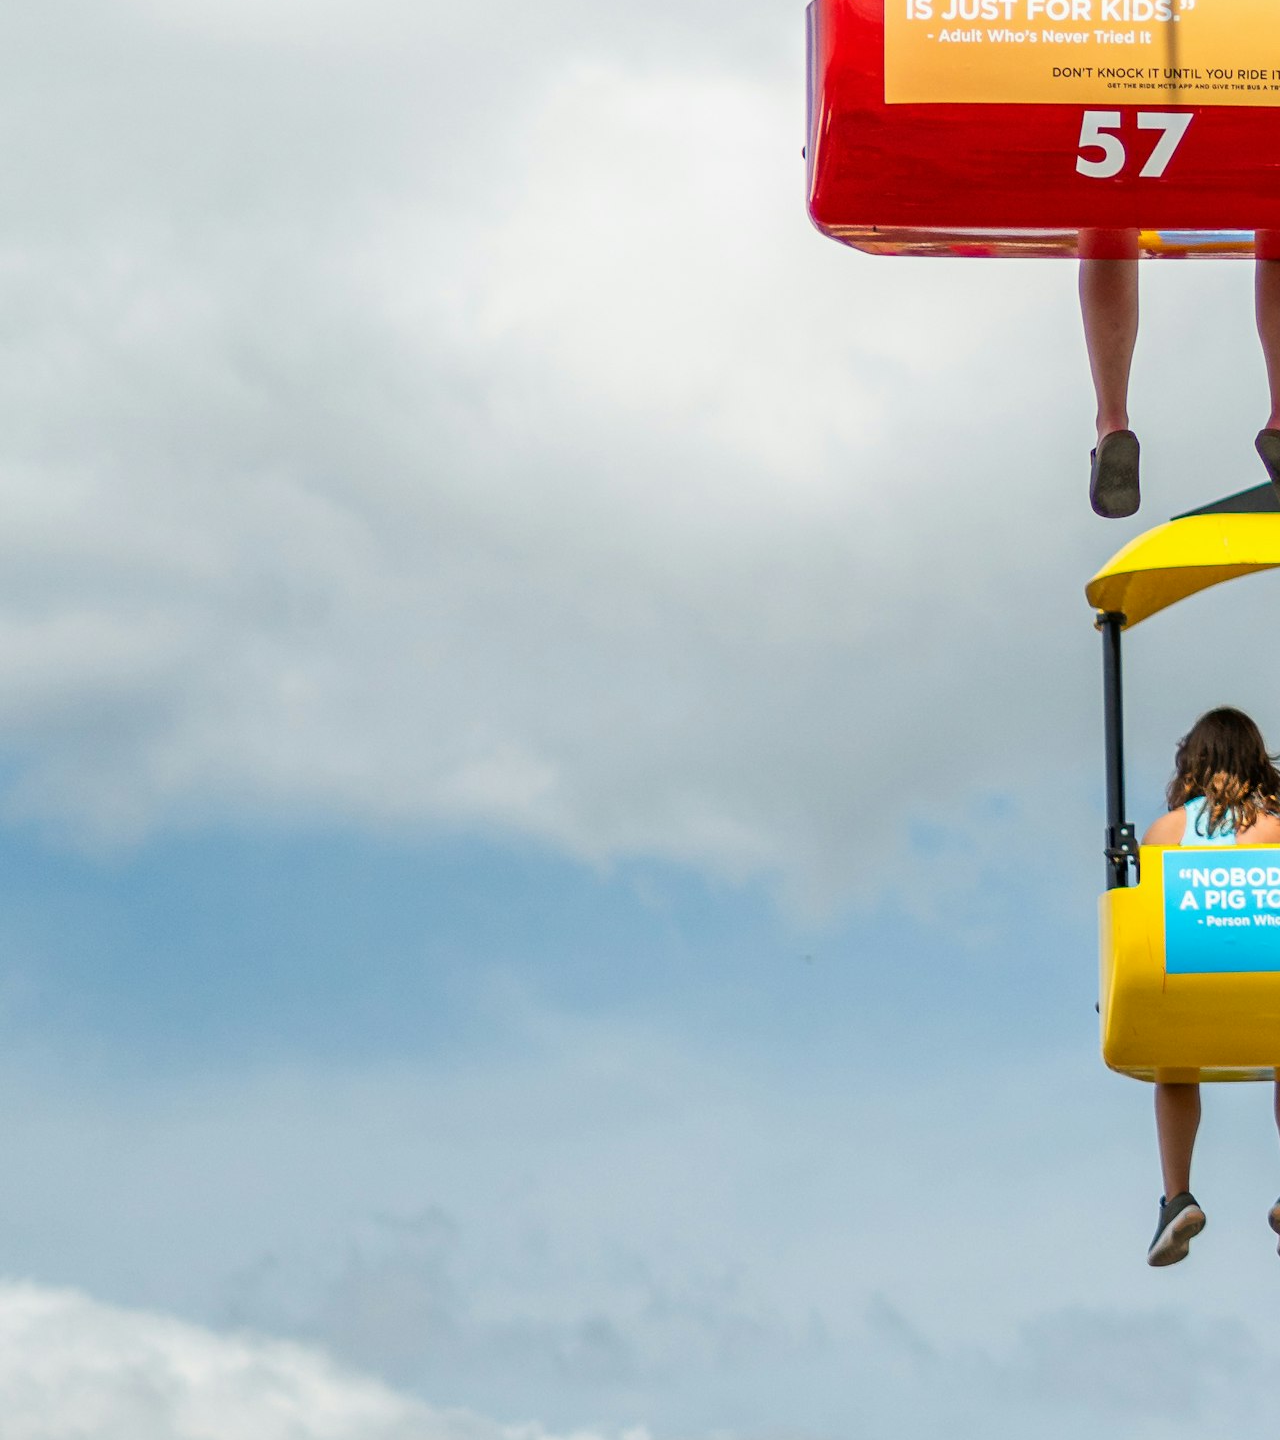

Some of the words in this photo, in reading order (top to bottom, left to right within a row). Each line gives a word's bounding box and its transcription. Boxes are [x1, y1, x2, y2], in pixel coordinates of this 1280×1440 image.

[938, 29, 983, 43] Adult
[987, 29, 1038, 43] Who’s
[1042, 29, 1089, 44] Never
[1093, 30, 1135, 44] Tried
[1139, 30, 1151, 44] It
[1052, 68, 1093, 78] DON’T
[1097, 68, 1144, 78] KNOCK
[1148, 69, 1159, 78] IT
[1164, 69, 1201, 79] UNTIL
[1205, 69, 1233, 79] YOU
[1238, 70, 1268, 80] RIDE
[1076, 110, 1194, 178] 57
[1180, 891, 1198, 910] A
[1206, 890, 1246, 910] PIG
[1206, 915, 1249, 927] Person
